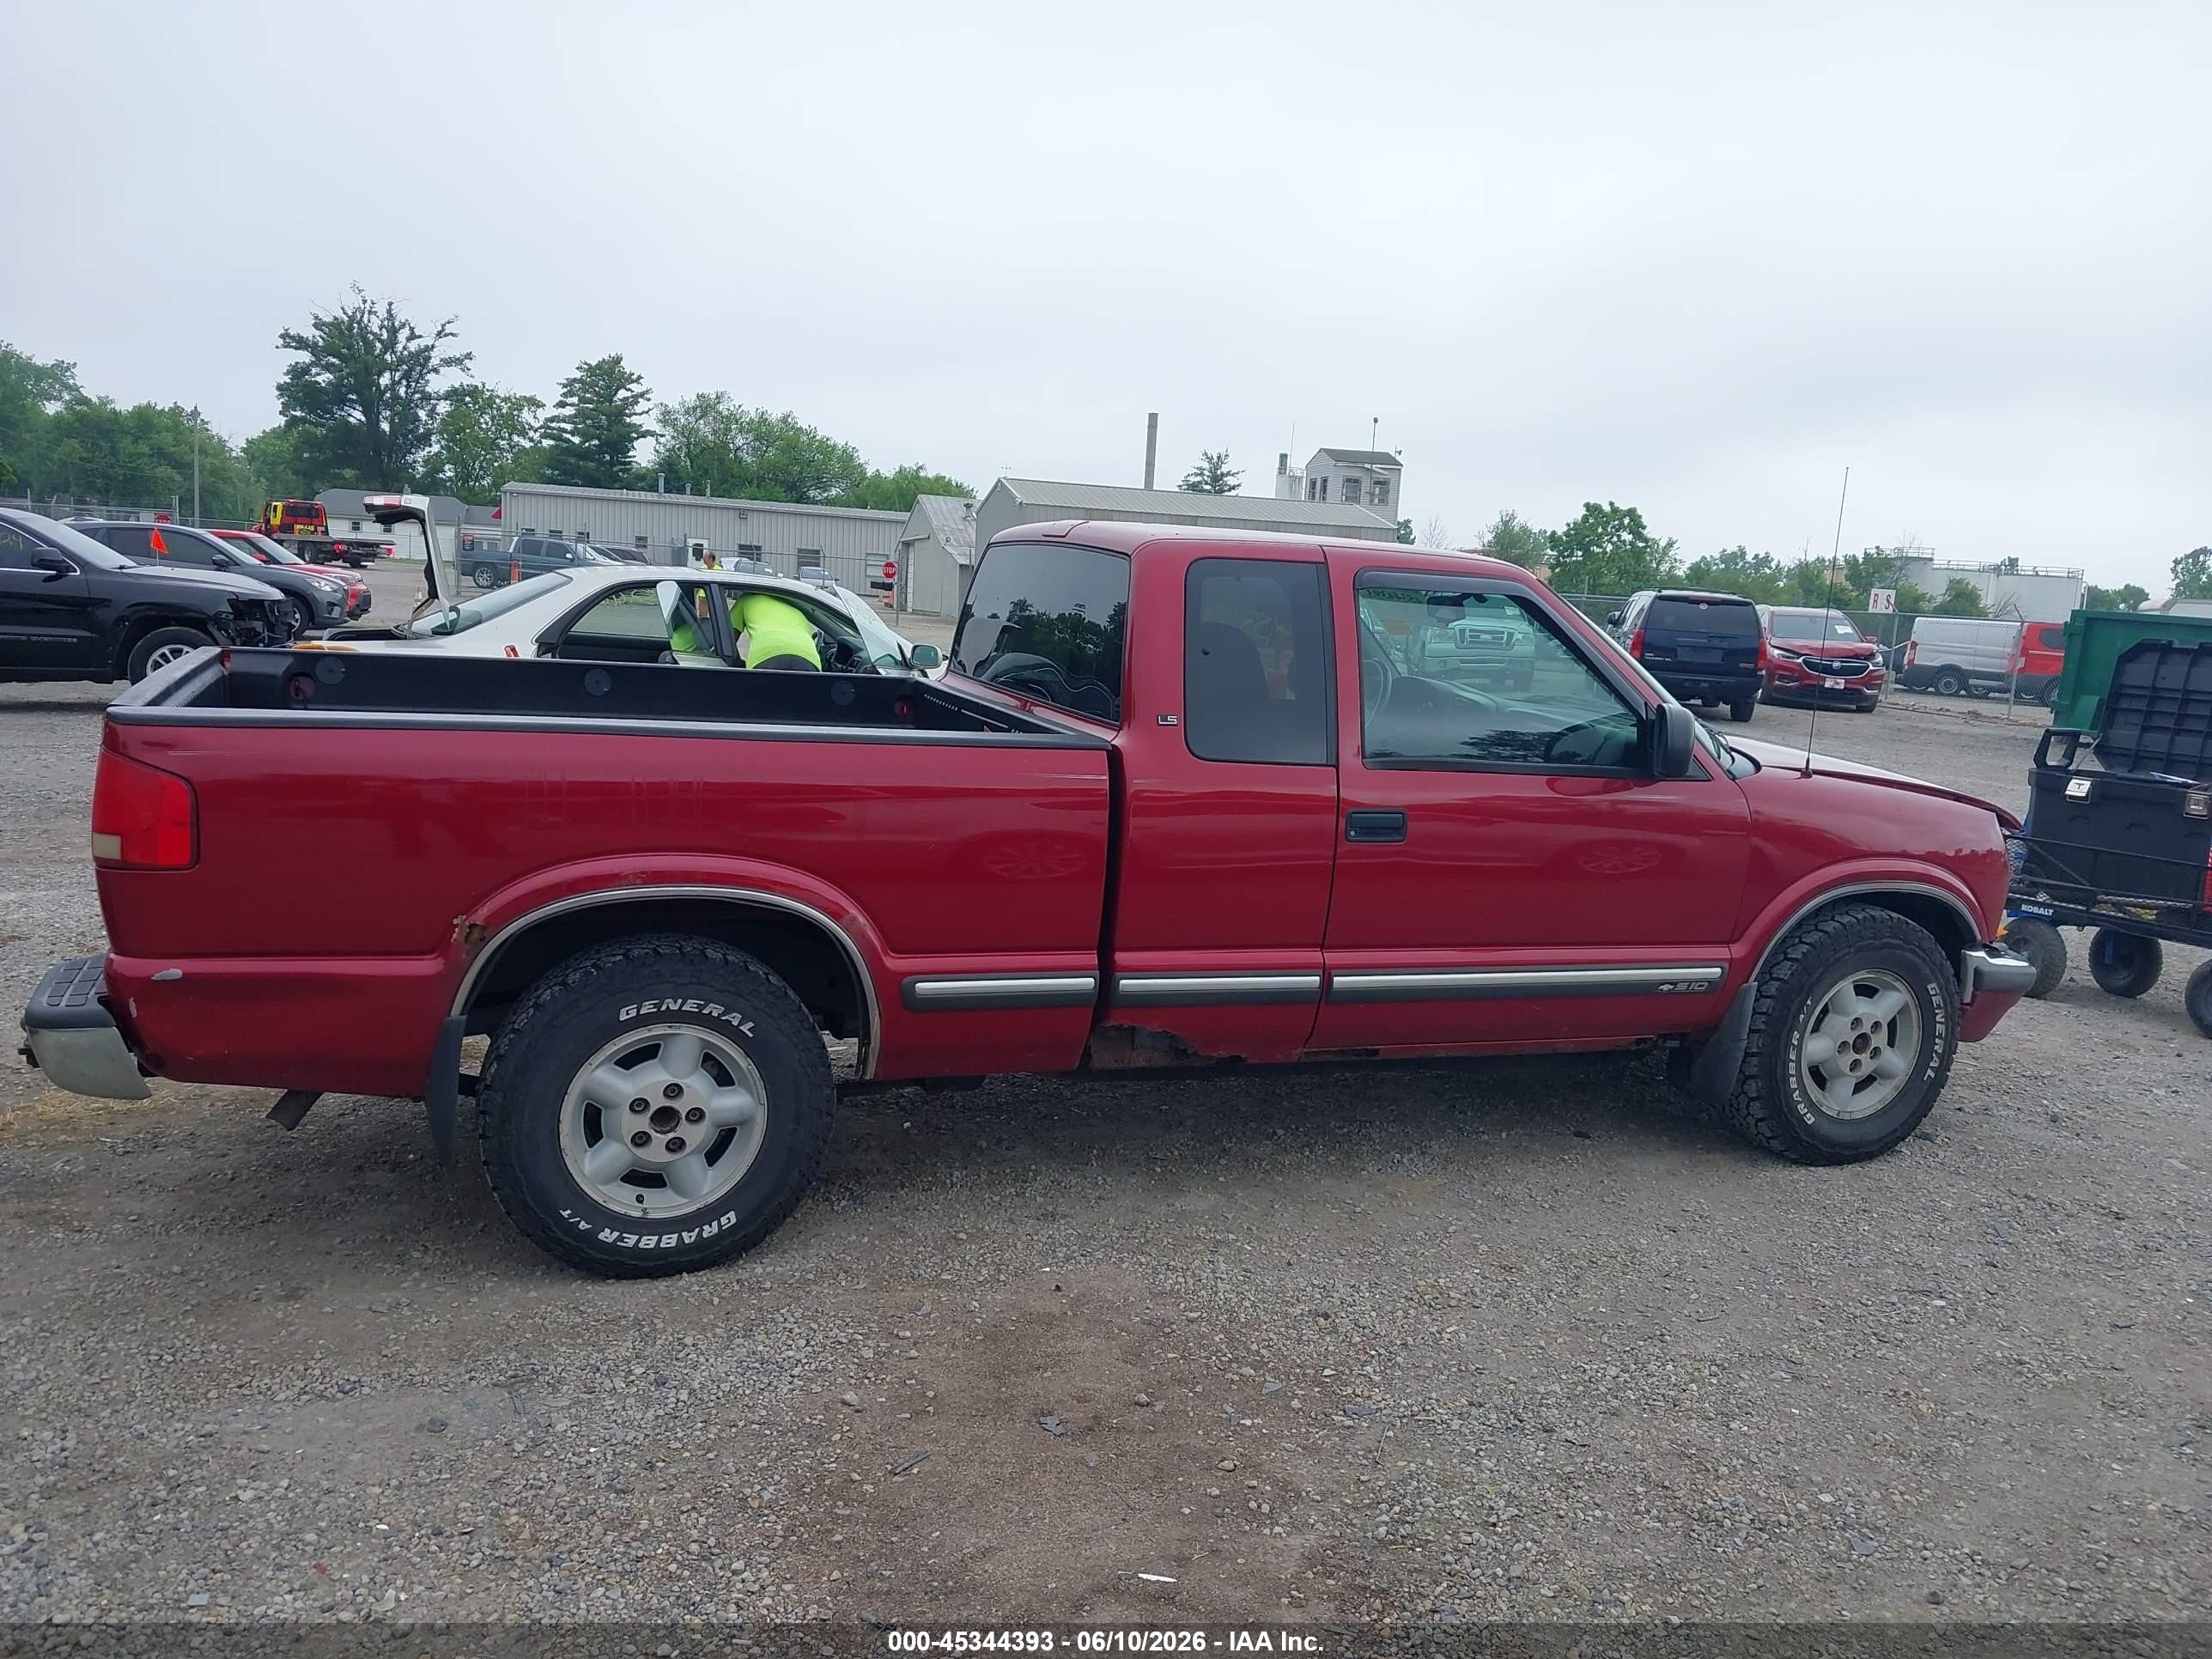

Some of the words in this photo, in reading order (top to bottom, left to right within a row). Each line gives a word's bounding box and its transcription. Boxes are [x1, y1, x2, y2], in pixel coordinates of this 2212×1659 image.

[1158, 715, 1177, 725] LS
[2021, 903, 2054, 917] KOBALT
[1674, 981, 1710, 990] S10
[618, 998, 756, 1038] GENERAL
[1798, 995, 1814, 1025] A/T
[1923, 982, 1946, 1082] GENERAL
[1787, 1030, 1815, 1126] GRABBER
[558, 1207, 593, 1231] A/T
[597, 1209, 738, 1249] GRABBER
